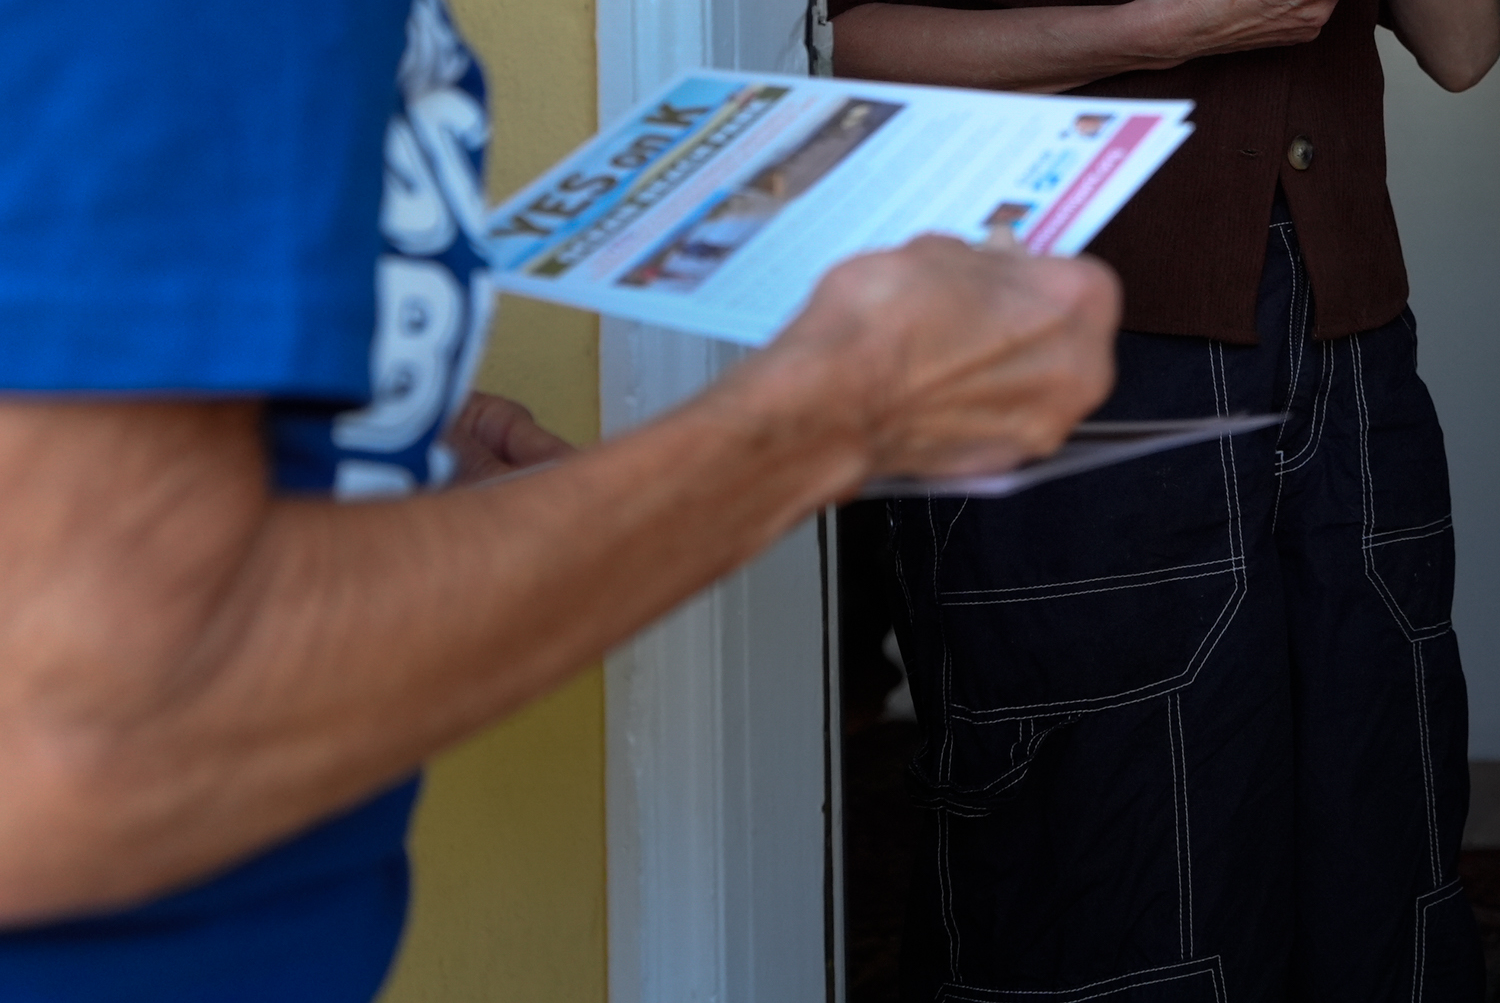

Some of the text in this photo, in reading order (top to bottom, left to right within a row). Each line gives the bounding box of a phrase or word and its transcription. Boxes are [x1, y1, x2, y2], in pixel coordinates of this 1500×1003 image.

[490, 100, 712, 236] YES on K
